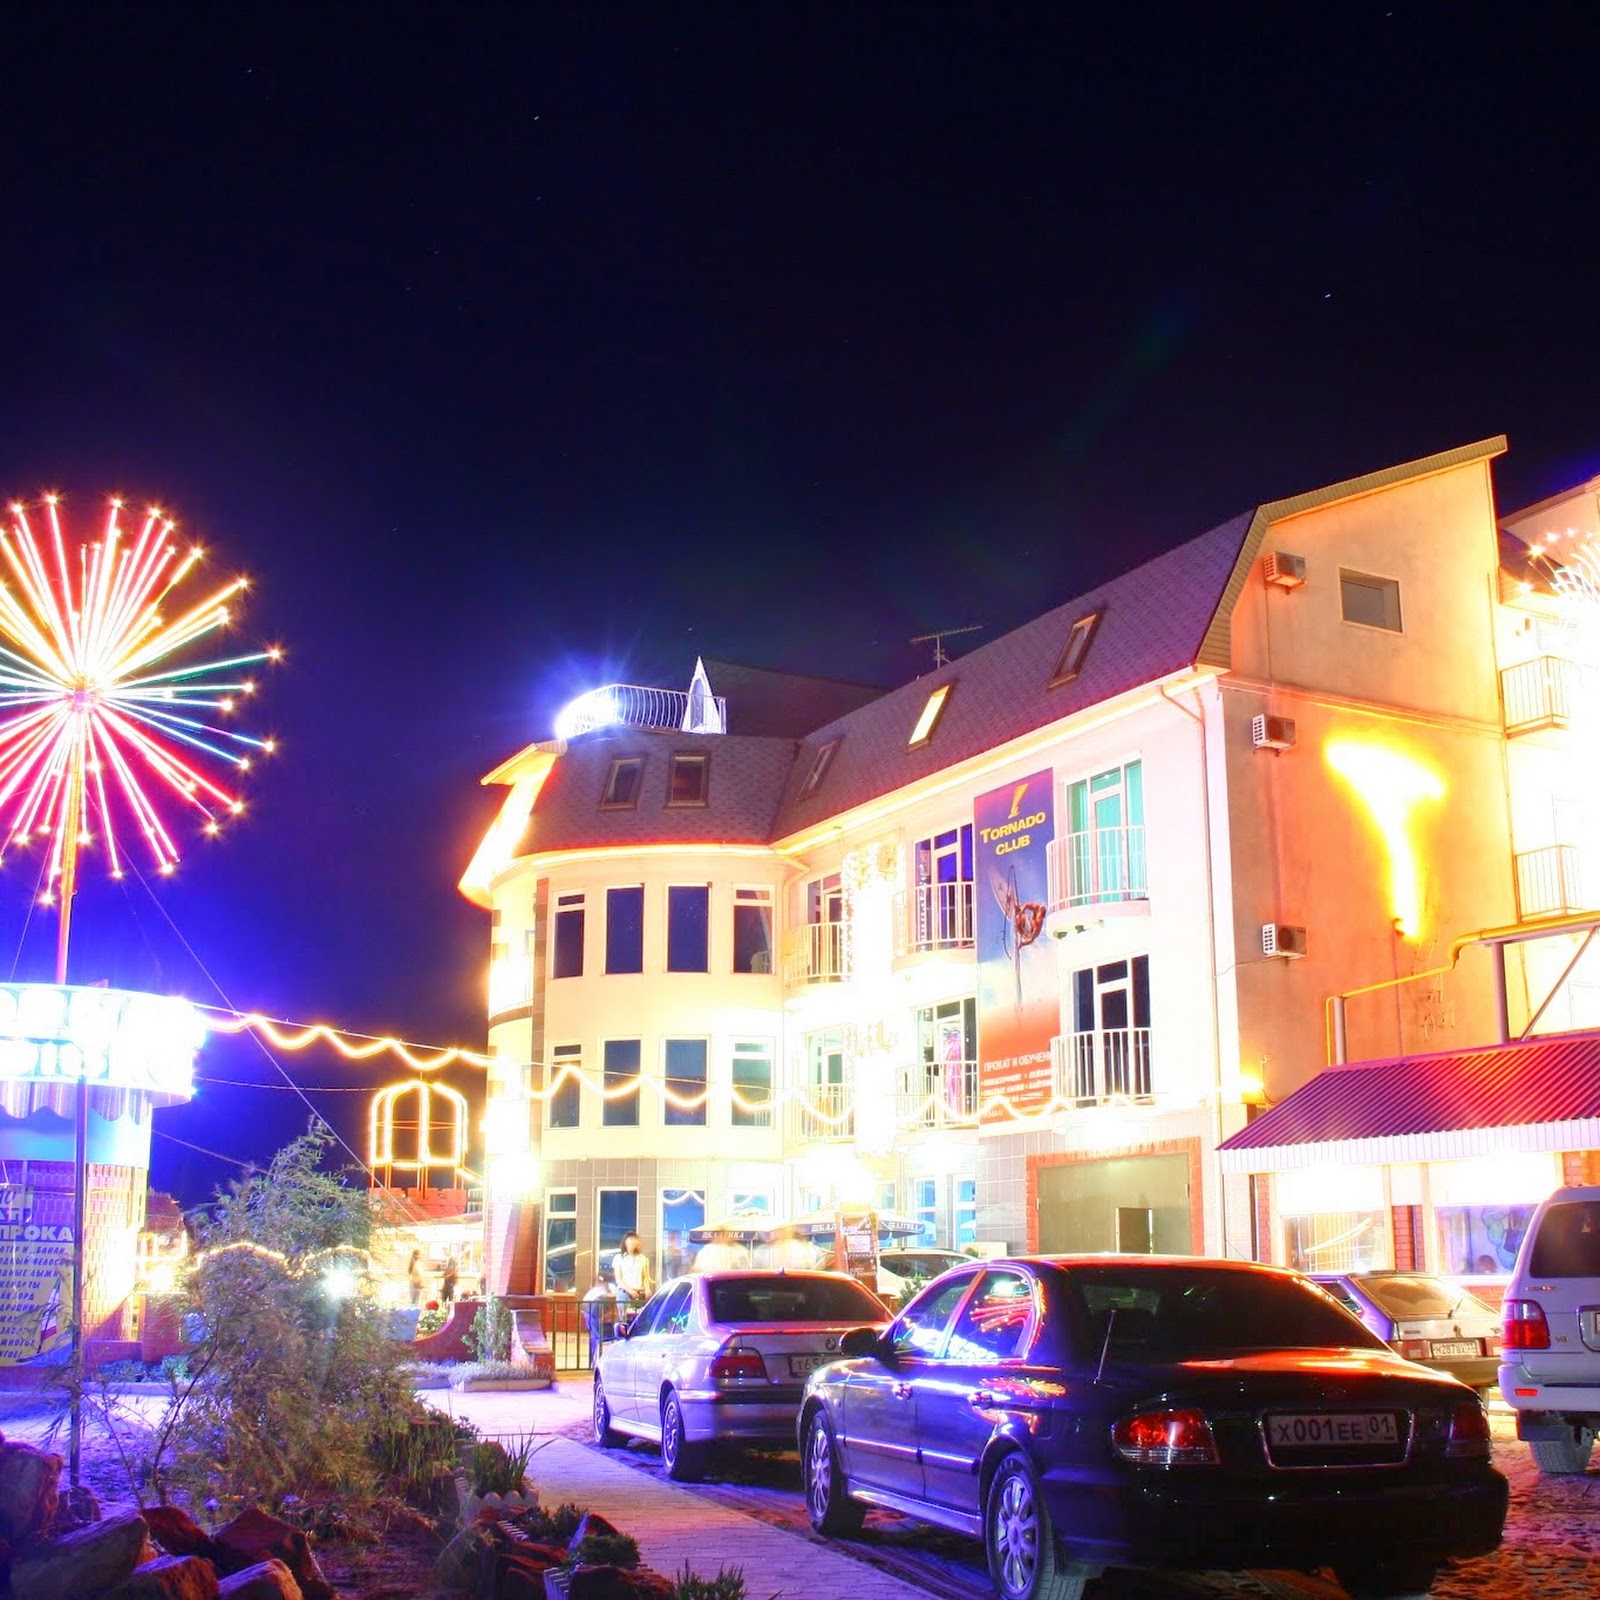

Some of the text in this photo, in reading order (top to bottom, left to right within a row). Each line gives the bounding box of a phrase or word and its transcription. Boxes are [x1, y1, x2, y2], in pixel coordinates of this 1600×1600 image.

[980, 812, 1046, 843] TORNADO
[996, 835, 1031, 855] CLUB
[984, 1058, 1011, 1072] ПРОКАТ
[1012, 1057, 1018, 1067] И
[0, 1225, 74, 1241] ПРОКА
[1278, 1416, 1390, 1442] Х001ЕЕ 01
